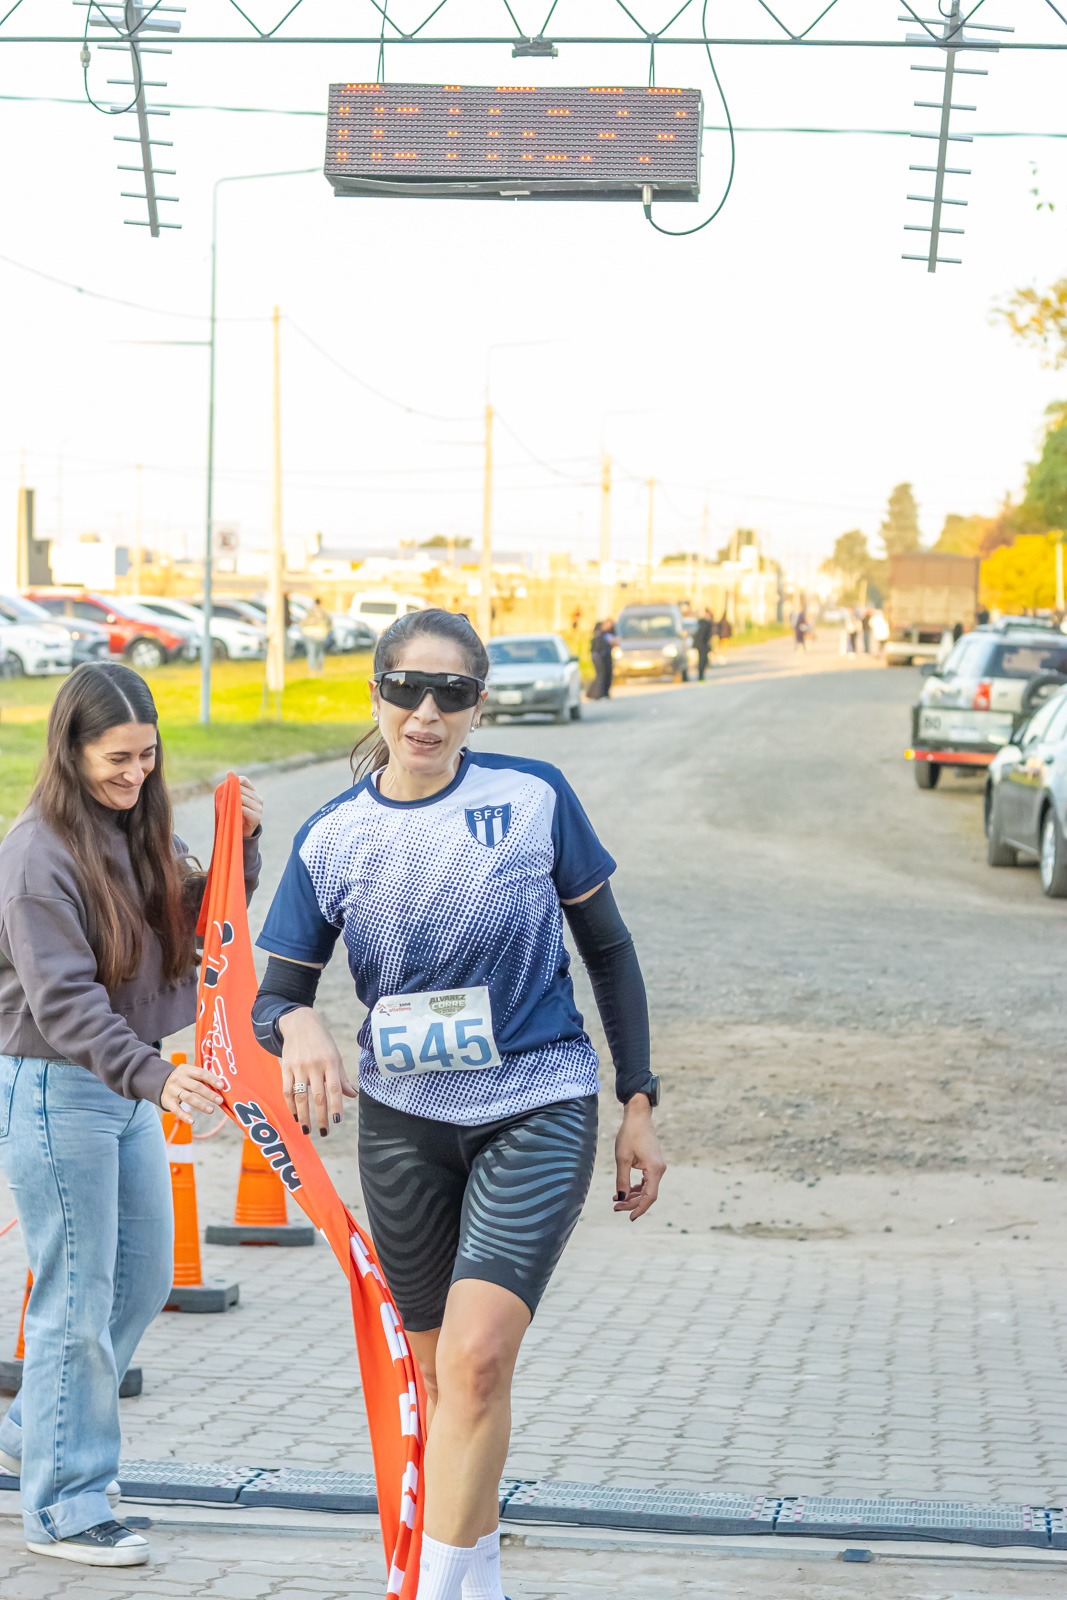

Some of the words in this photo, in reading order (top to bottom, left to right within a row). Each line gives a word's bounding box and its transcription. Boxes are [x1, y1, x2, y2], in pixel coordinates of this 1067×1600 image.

[473, 808, 503, 821] SFC
[429, 994, 466, 1004] ALVAREZ
[431, 1000, 465, 1010] CORRE
[379, 1018, 492, 1073] 545
